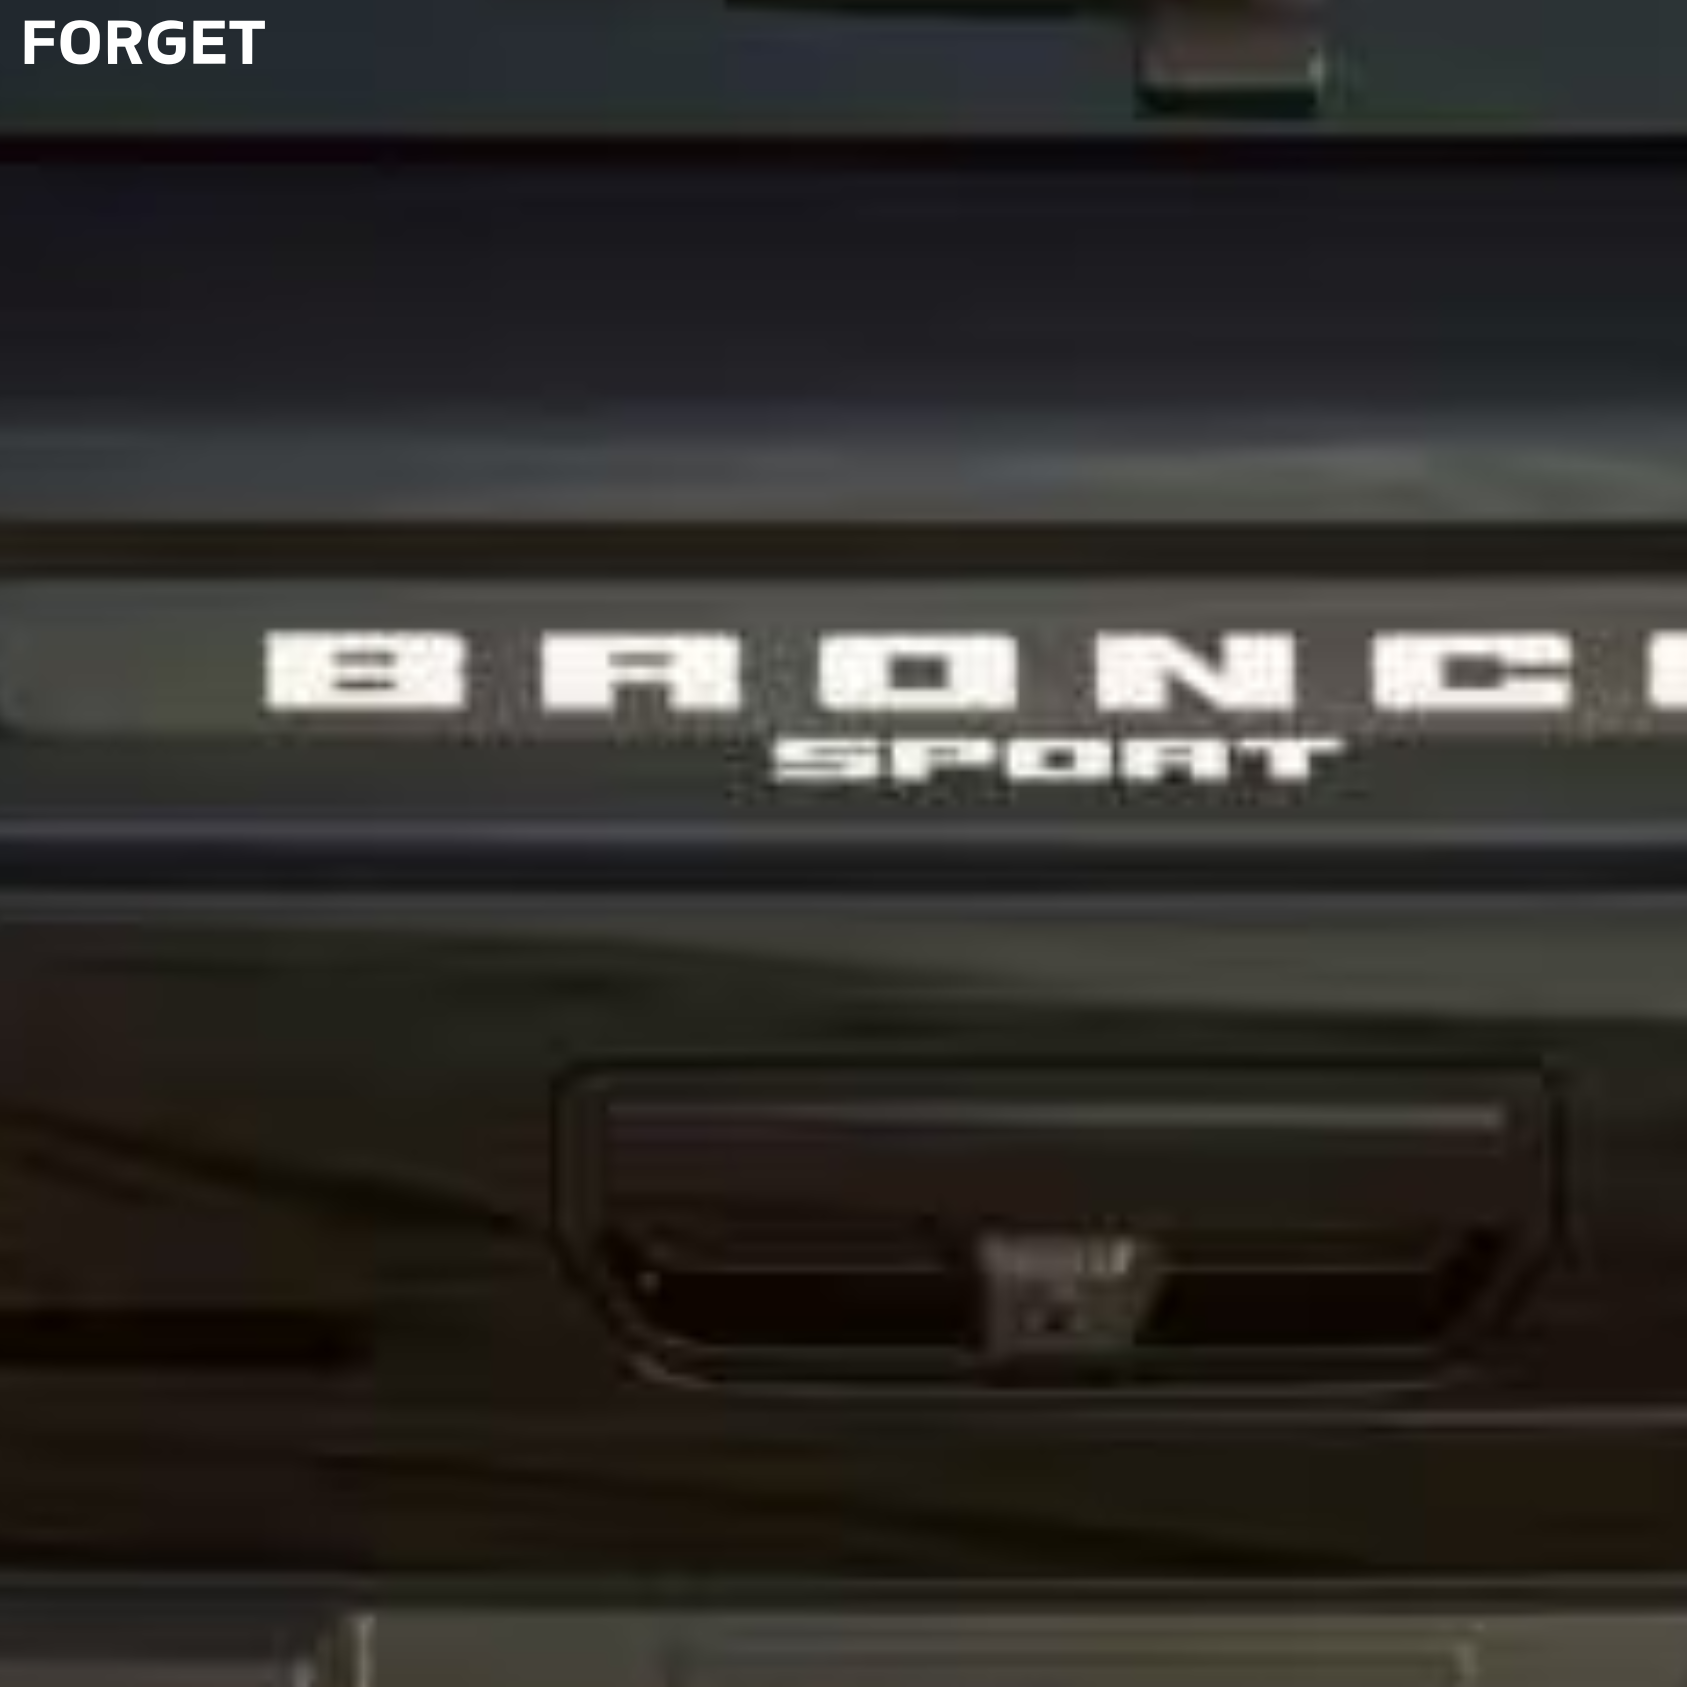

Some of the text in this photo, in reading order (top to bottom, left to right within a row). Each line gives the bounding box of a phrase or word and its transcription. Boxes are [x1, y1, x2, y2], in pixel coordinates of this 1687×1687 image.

[24, 19, 266, 65] FORGET
[264, 630, 1687, 714] BRONC
[771, 735, 1345, 784] SPORT
